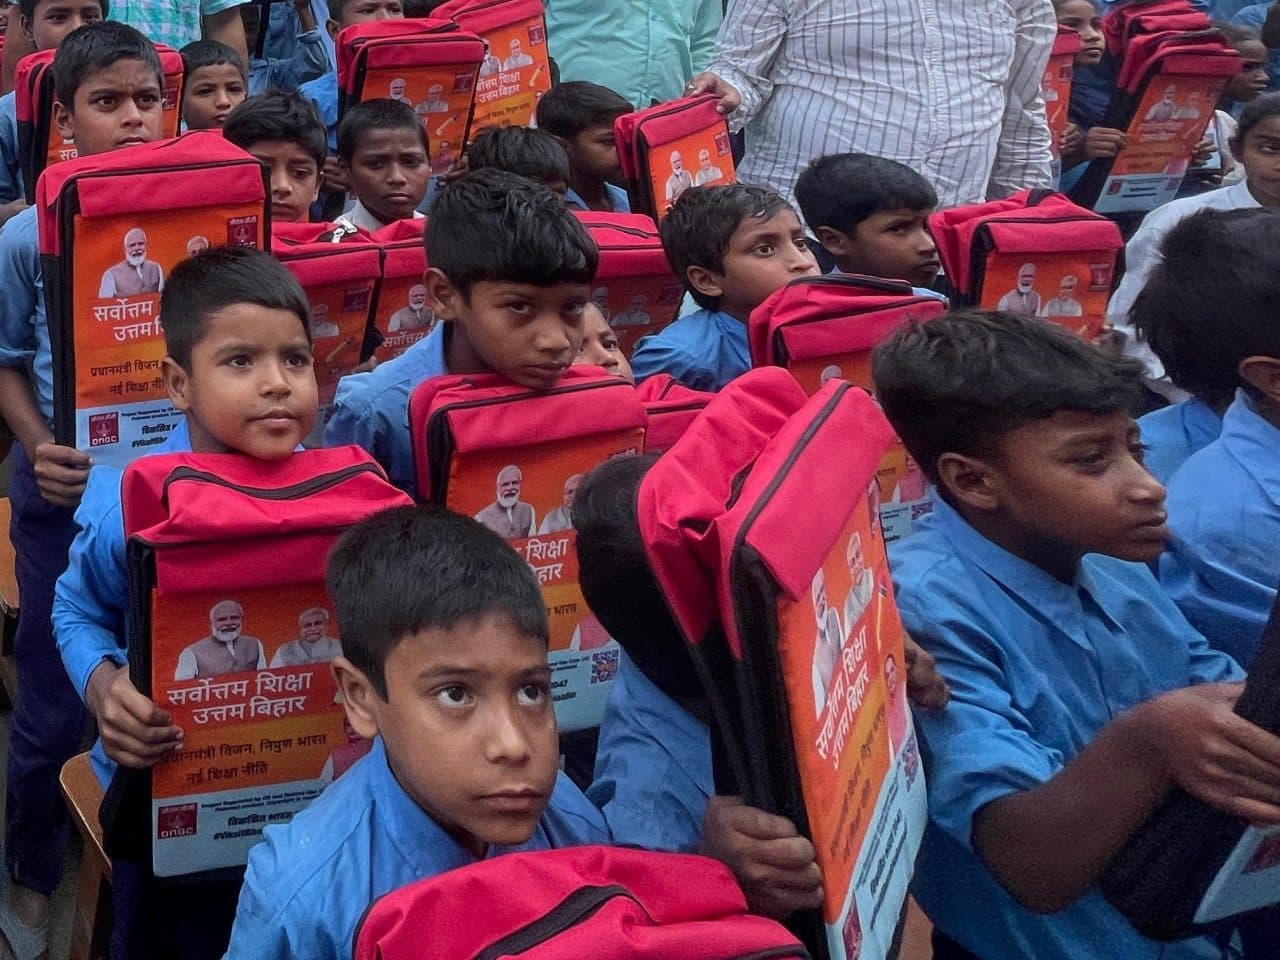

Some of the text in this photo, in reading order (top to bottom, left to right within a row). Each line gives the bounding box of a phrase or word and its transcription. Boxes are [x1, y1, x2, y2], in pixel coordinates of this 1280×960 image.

[500, 71, 521, 86] शिक्षा
[479, 84, 521, 103] उत्तम बिहार
[93, 298, 153, 323] सर्वोत्तम
[113, 321, 151, 341] उत्तम
[90, 360, 132, 377] प्रधानमंत्री
[125, 381, 149, 394] शिक्षा
[92, 436, 117, 445] ONGC
[526, 538, 569, 562] शिक्षा
[554, 603, 577, 617] भारत
[167, 671, 313, 706] सर्वोत्तम शिक्षा
[192, 695, 307, 724] उत्तम बिहार
[260, 739, 293, 753] निपुण
[297, 733, 327, 746] भारत
[208, 766, 238, 782] शिक्षा
[242, 761, 268, 776] नीति
[161, 827, 194, 838] ONGC
